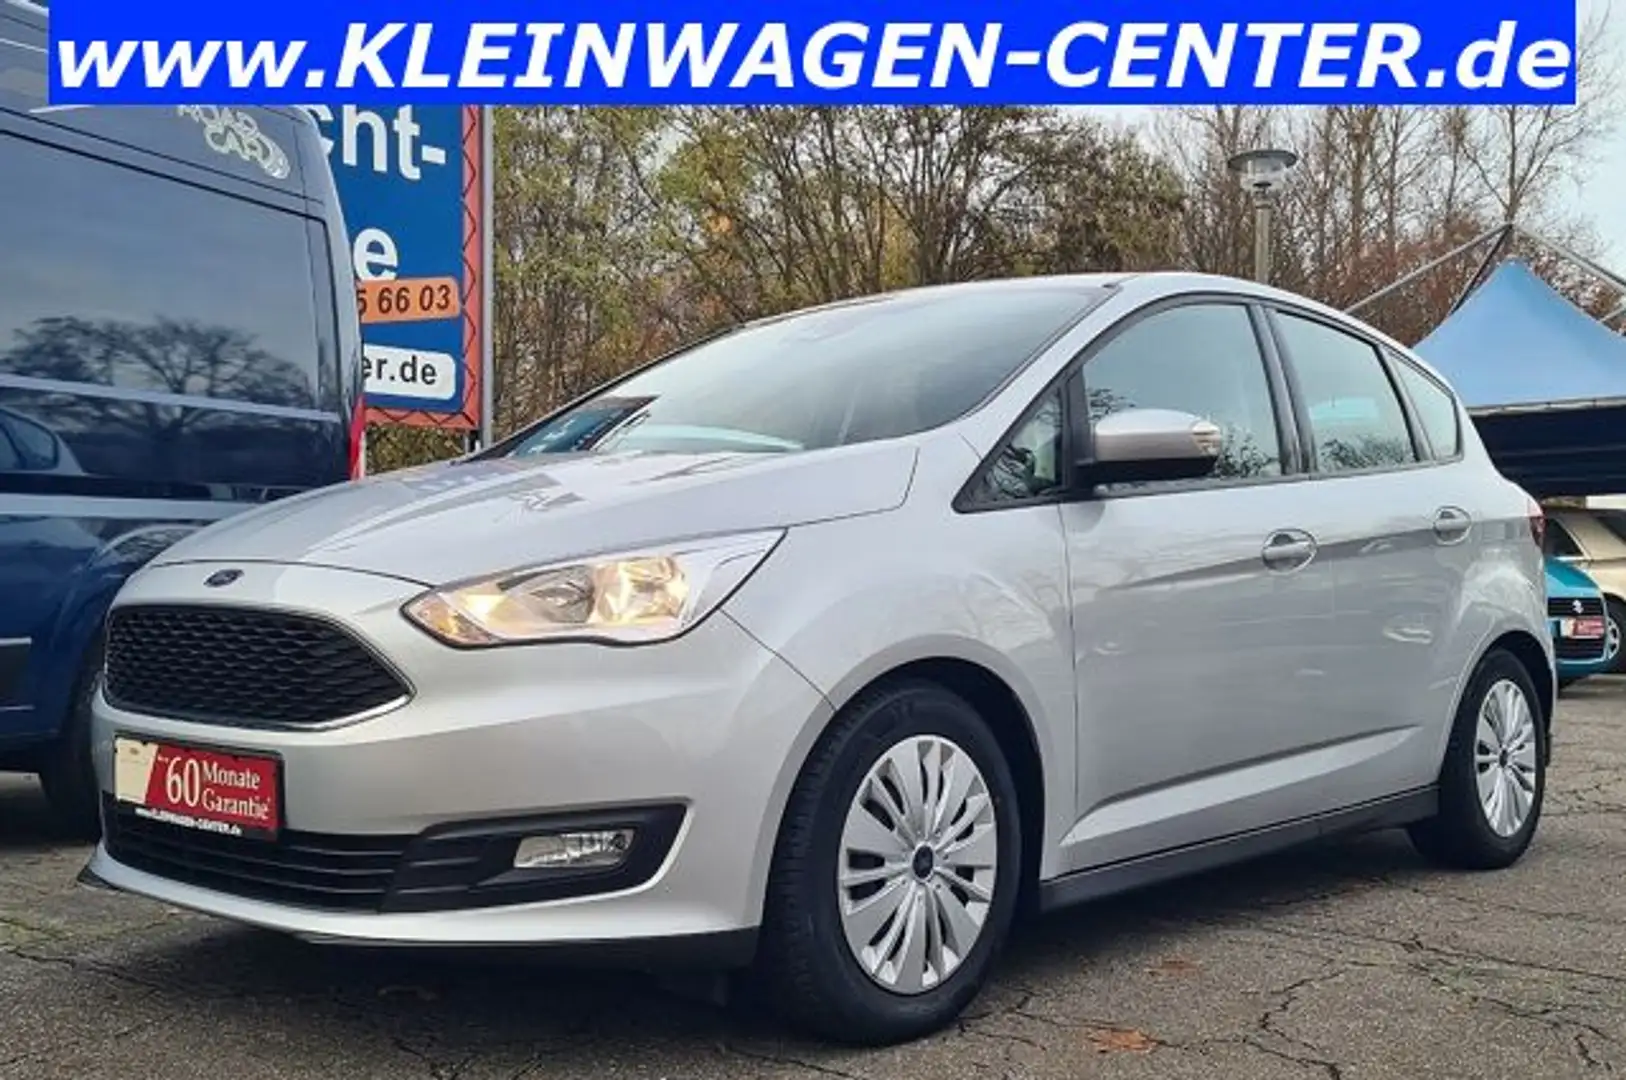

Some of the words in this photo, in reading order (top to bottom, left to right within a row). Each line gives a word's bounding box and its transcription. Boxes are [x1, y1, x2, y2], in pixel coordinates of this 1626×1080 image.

[377, 286, 411, 314] 66
[419, 284, 451, 312] 03
[166, 755, 200, 808] 60
[202, 760, 261, 790] Monate
